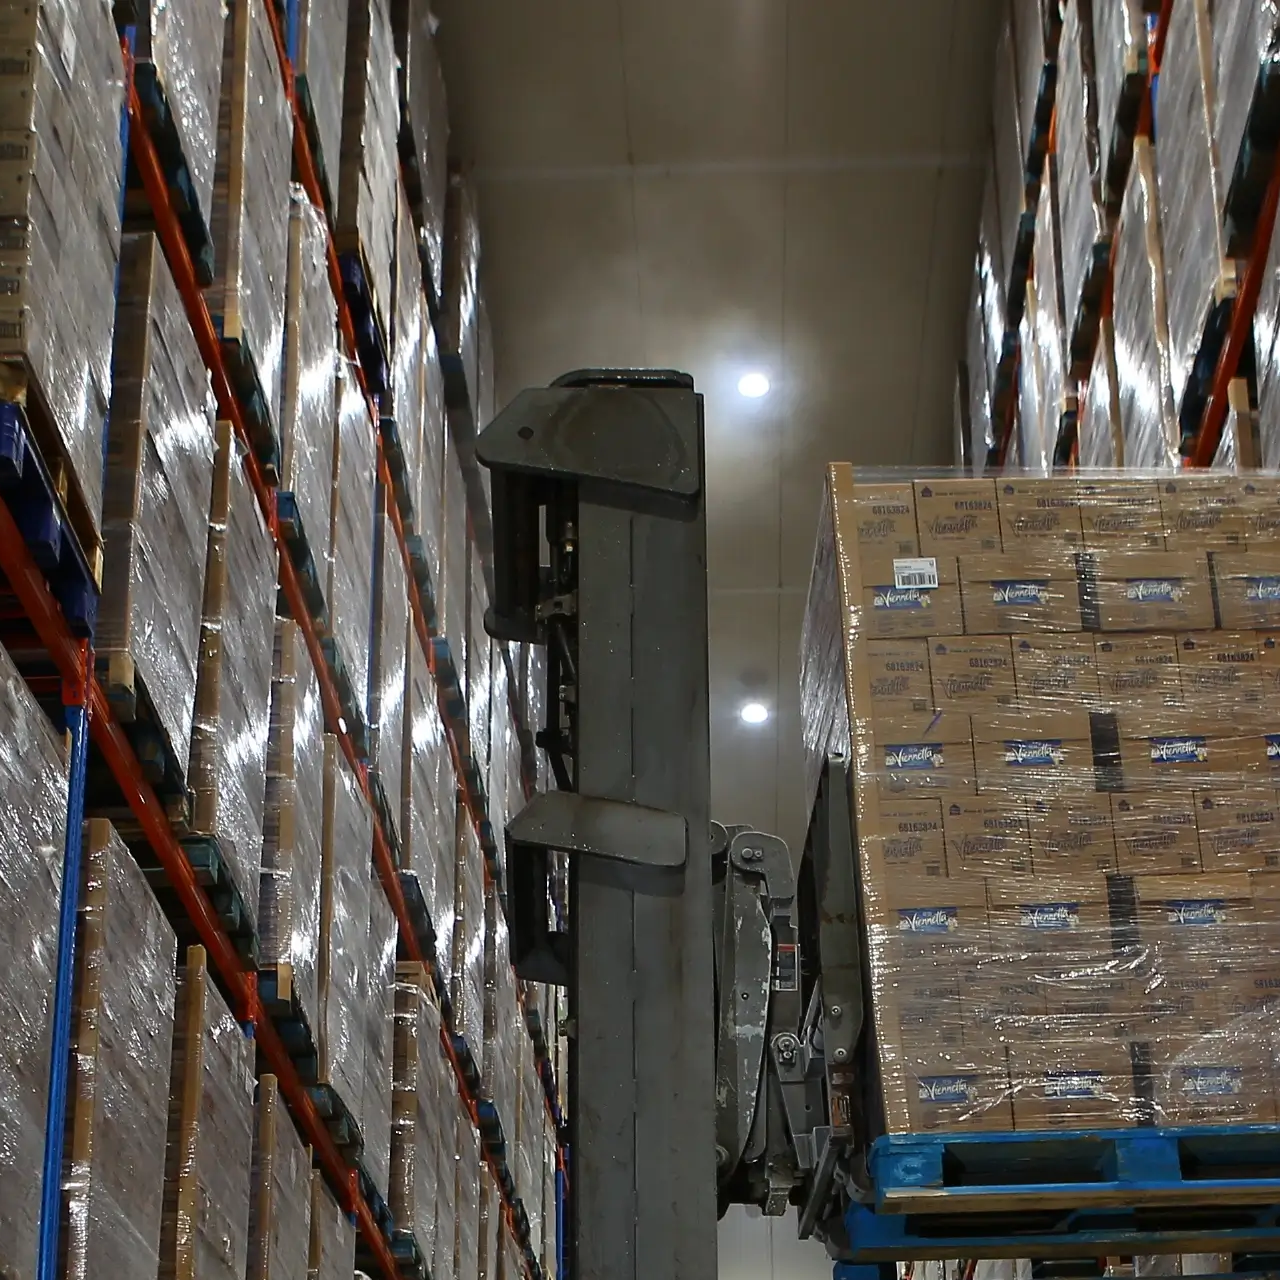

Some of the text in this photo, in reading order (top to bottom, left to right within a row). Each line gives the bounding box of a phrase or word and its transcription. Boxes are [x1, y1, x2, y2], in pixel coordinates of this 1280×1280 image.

[881, 586, 920, 607] Viennetta
[999, 584, 1040, 603] Viennetta
[892, 746, 933, 767] Viennetta
[1011, 744, 1052, 763] Viennetta
[1160, 740, 1197, 760] Viennetta
[905, 911, 947, 931] Viennetta
[1028, 908, 1068, 928] Viennetta
[1174, 903, 1214, 924] Viennetta
[926, 1079, 968, 1100] Viennetta
